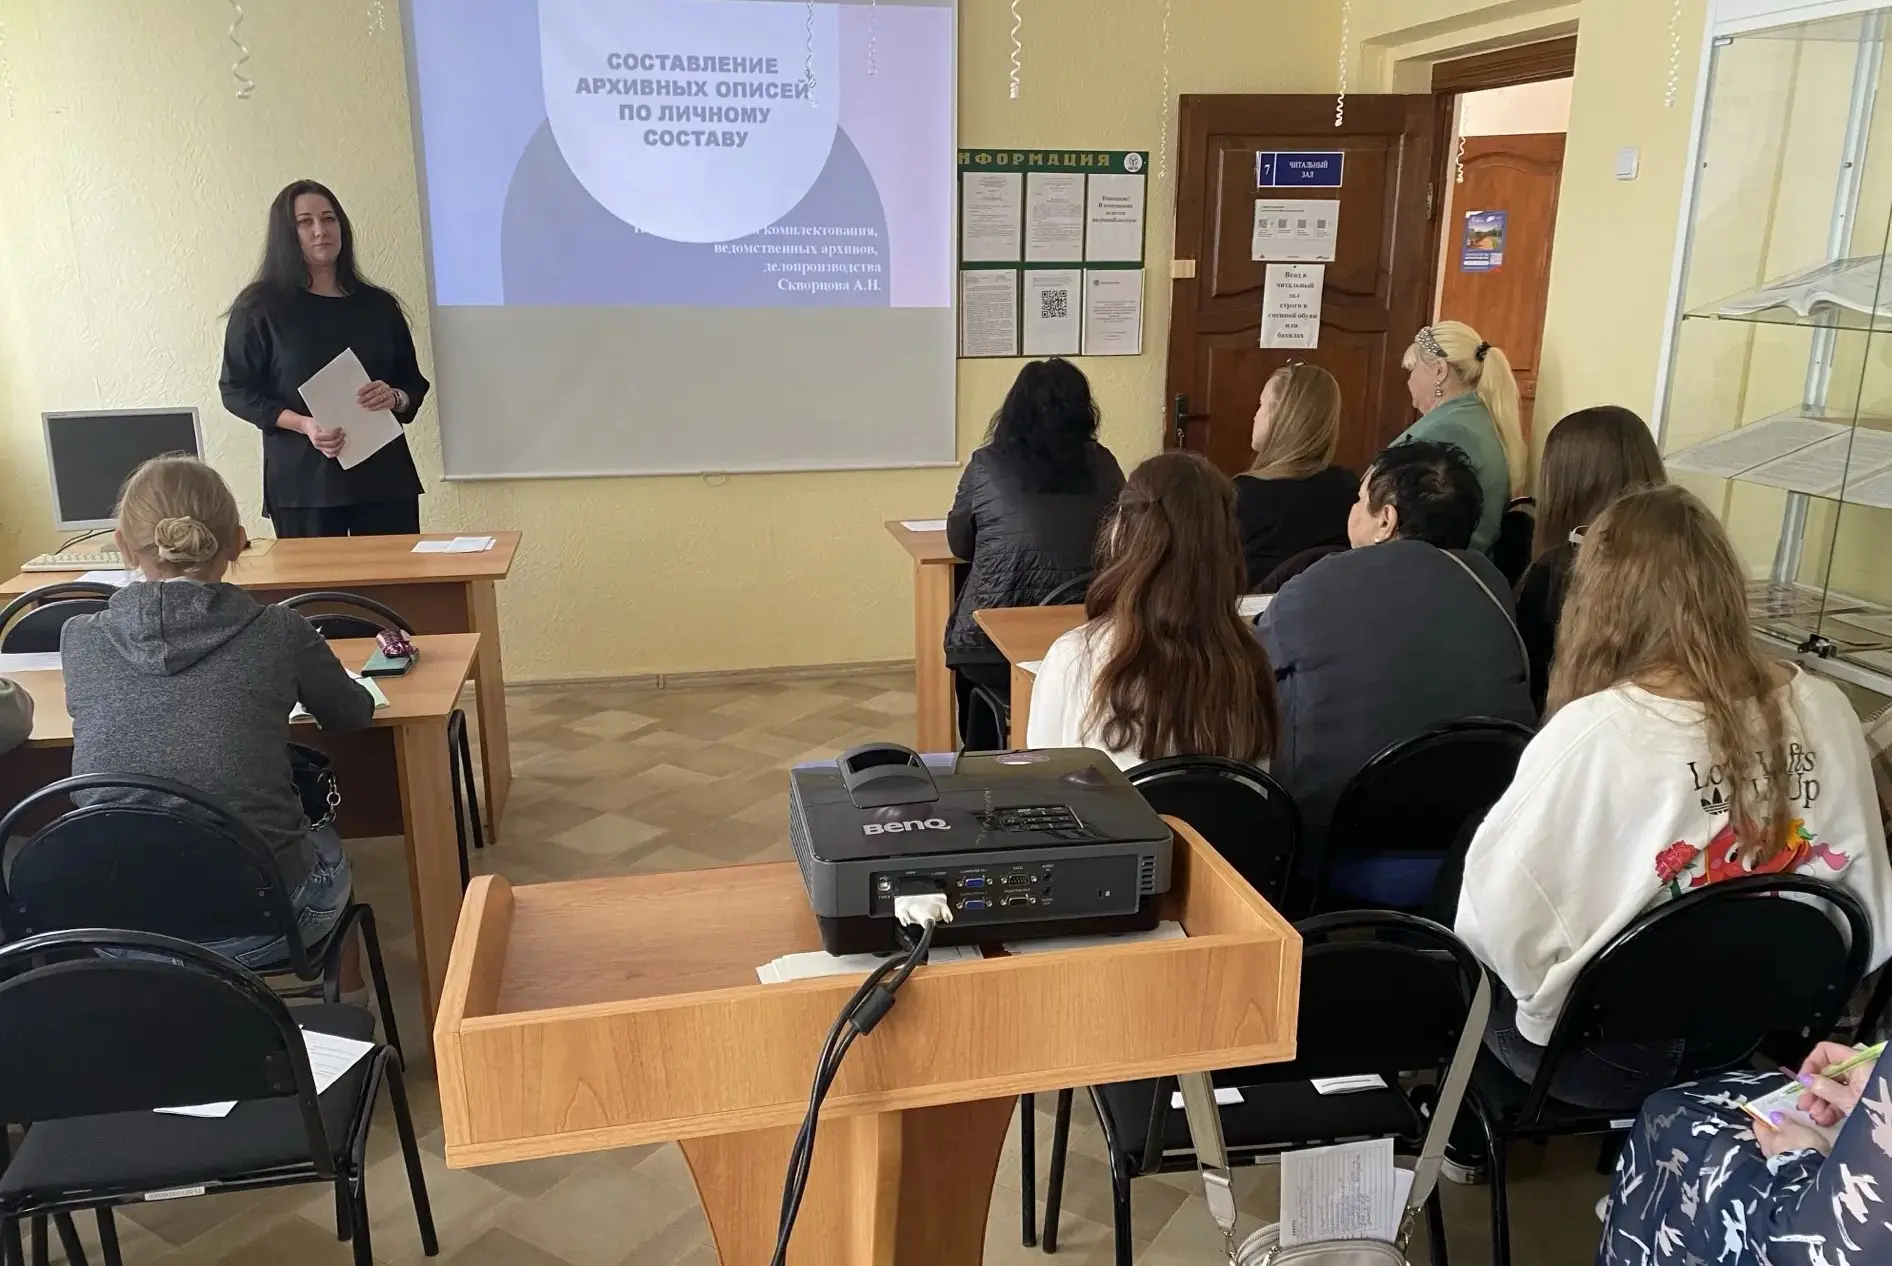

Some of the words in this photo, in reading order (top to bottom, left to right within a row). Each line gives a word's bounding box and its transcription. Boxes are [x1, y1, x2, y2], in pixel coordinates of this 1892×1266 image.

[606, 52, 779, 74] СОСТАВЛЕНИЕ
[575, 77, 710, 98] АРХИВНЫХ
[715, 79, 809, 100] ОПИСЕЙ
[618, 103, 652, 122] ПО
[657, 104, 772, 124] ЛИЧНОМУ
[643, 128, 749, 148] СОСТАВУ
[957, 151, 1111, 167] НФОРМАЦИЯ
[1289, 160, 1329, 169] ЧИТАЛЬНЫЙ
[1264, 163, 1271, 176] 7
[1301, 171, 1314, 179] ЗАЛ
[763, 226, 878, 237] комплектования,
[714, 243, 818, 255] ведомственных
[820, 244, 878, 257] архивов,
[763, 262, 882, 275] делопроизводства
[777, 278, 850, 293] Скворцова
[853, 279, 881, 291] А.Н.
[862, 818, 951, 836] BenQ
